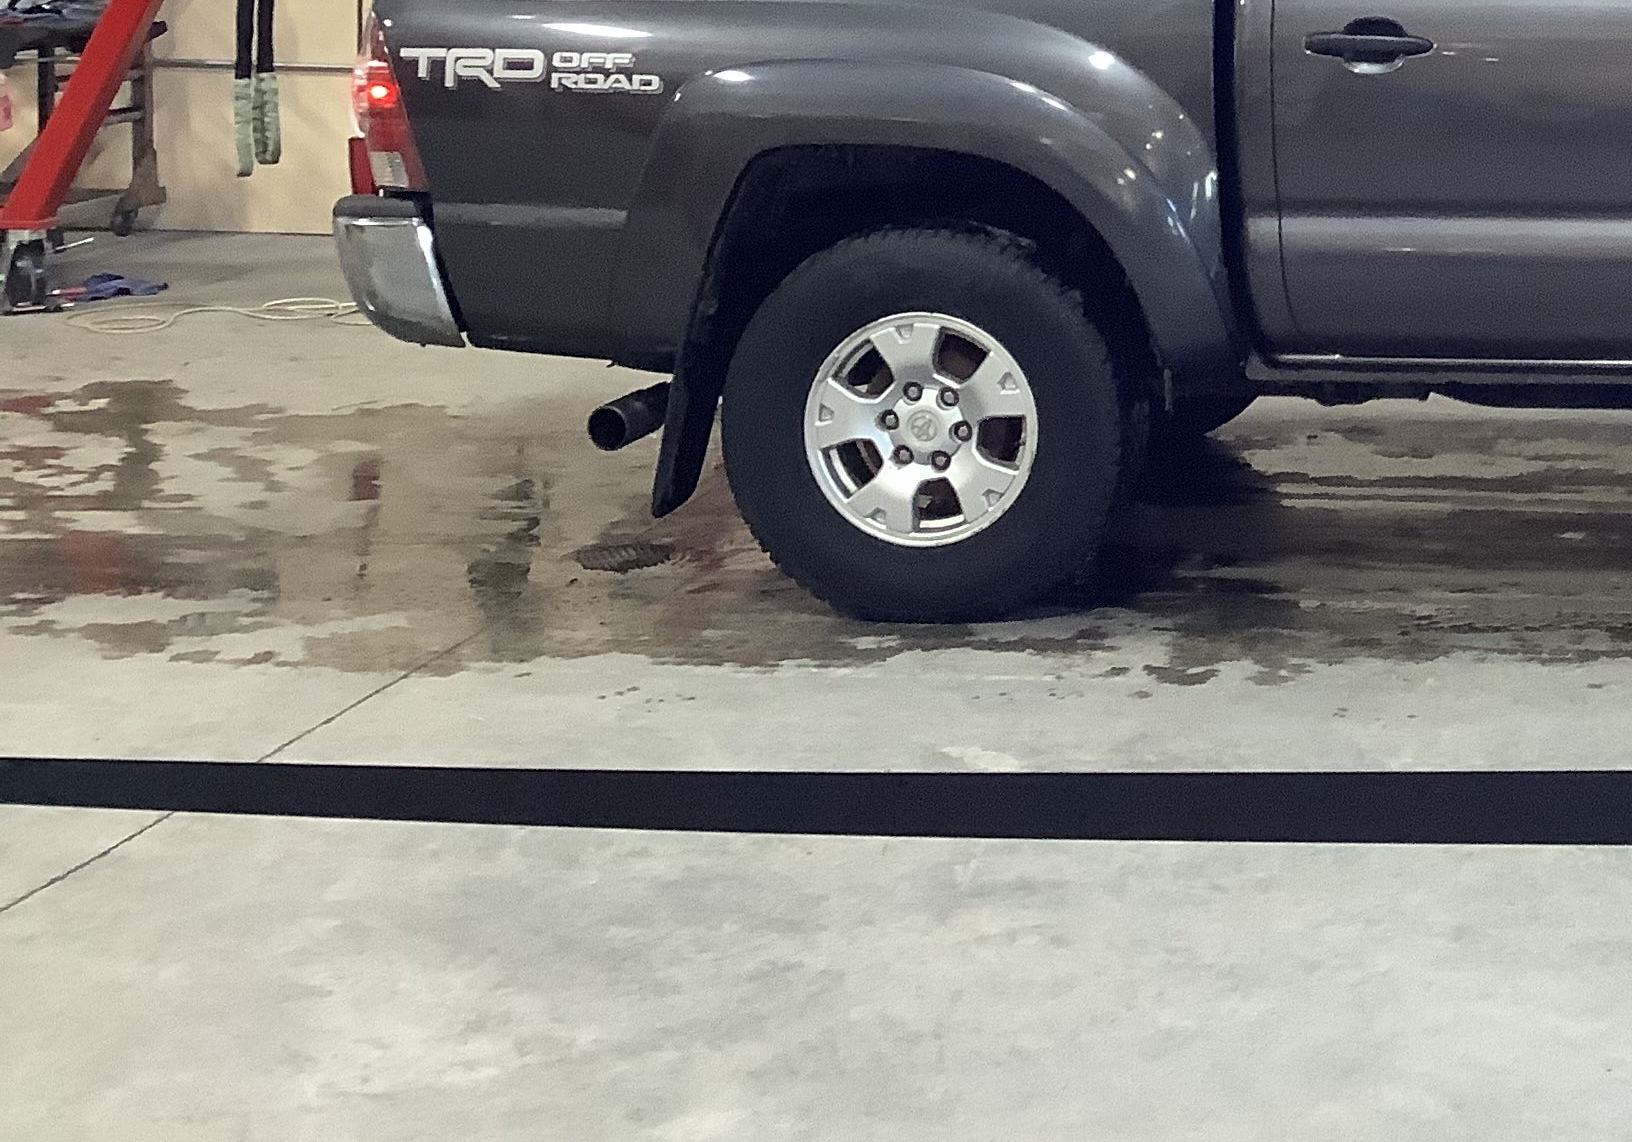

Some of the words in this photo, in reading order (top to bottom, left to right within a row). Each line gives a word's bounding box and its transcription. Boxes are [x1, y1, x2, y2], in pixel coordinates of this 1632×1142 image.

[399, 47, 546, 90] TRD
[551, 51, 636, 69] OFF
[550, 72, 663, 94] ROAD
